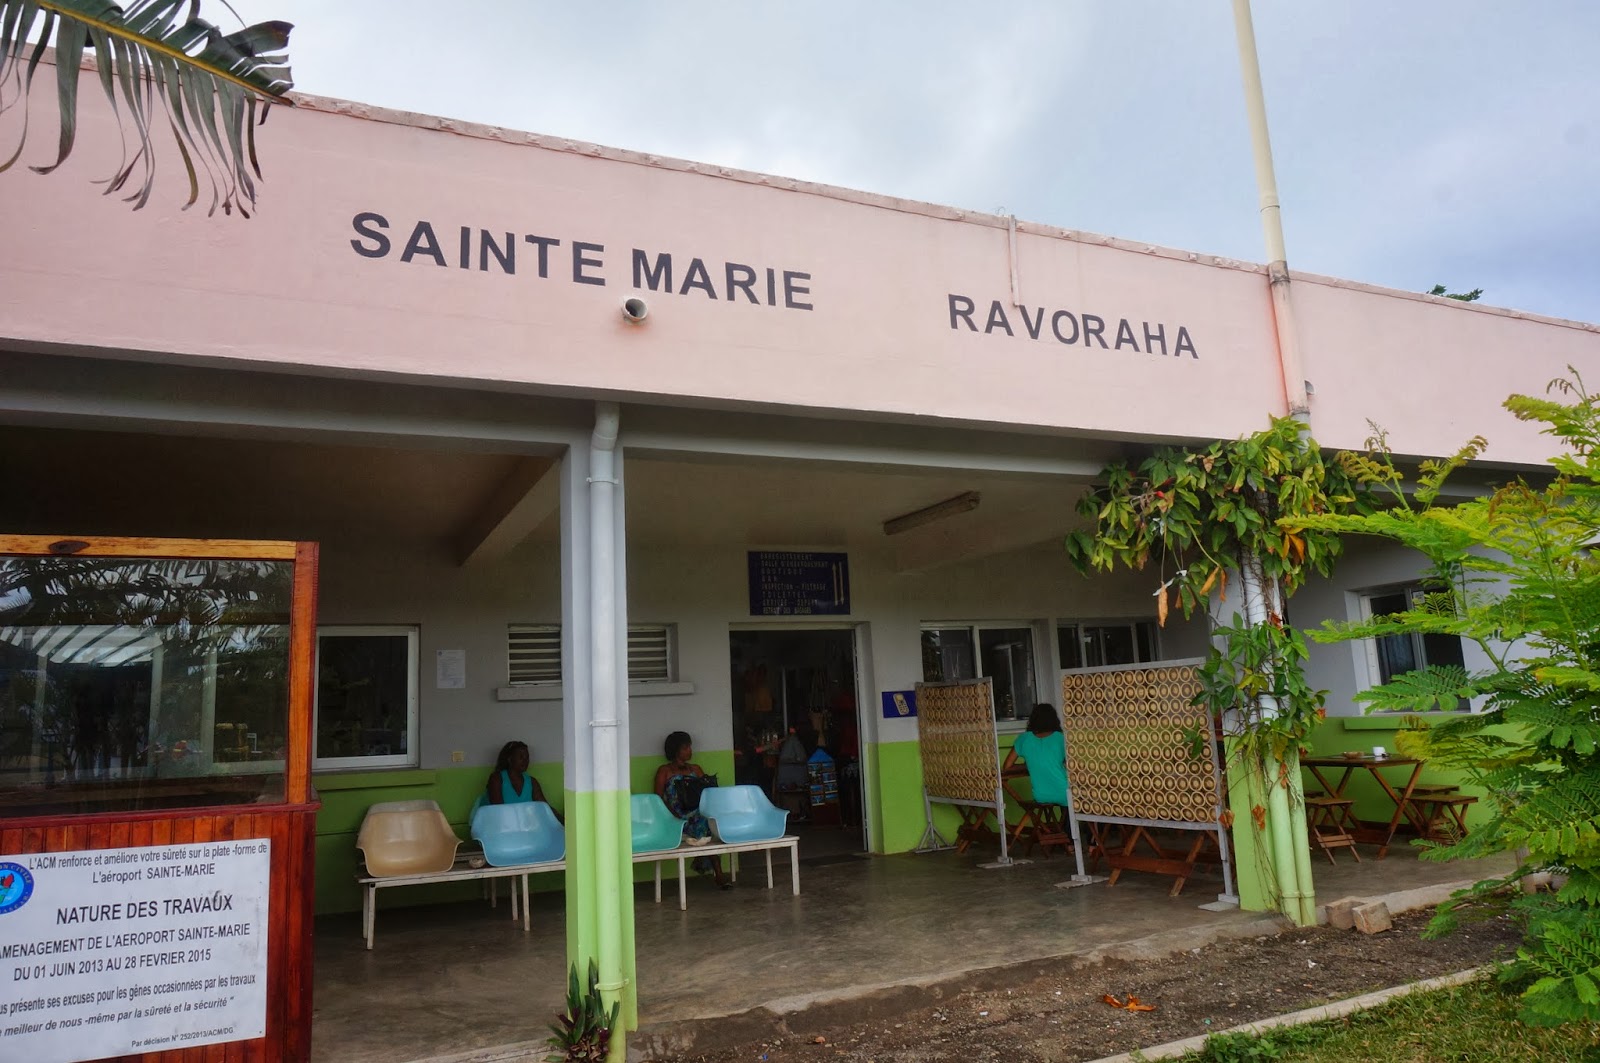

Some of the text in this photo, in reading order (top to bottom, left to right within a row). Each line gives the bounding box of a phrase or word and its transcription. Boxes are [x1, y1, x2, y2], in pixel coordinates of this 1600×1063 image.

[350, 212, 1199, 359] SAINTE MARIE RAVORAHA
[29, 856, 57, 870] L'ACM
[58, 855, 92, 868] renforce
[94, 854, 102, 866] et
[104, 851, 138, 865] améliore
[140, 851, 160, 862] votre
[162, 847, 187, 860] sûreté
[188, 849, 202, 859] sur
[203, 846, 210, 857] la
[211, 845, 230, 859] plate
[258, 842, 267, 853] de
[92, 862, 216, 884] L'aéroport SAINTE-MARIE
[56, 894, 233, 925] NATURE DES TRAVAUX
[0, 923, 251, 959] MENAGEMENT DE L'AEROPORT SAINTE-MARIE
[14, 948, 211, 981] DU 01 JUIN 2013 AU 28 FEVRIER 2015
[10, 998, 45, 1017] présente
[47, 996, 61, 1009] ses
[63, 992, 95, 1006] excuses
[96, 989, 115, 1005] pour
[116, 986, 127, 1000] les
[129, 984, 151, 1001] gênes
[153, 978, 203, 995] occasionnées
[204, 978, 217, 992] par
[218, 975, 228, 988] les
[230, 974, 256, 986] travaux
[4, 1023, 44, 1037] meilleur
[45, 1019, 57, 1031] de
[59, 1017, 82, 1029] nous
[117, 1010, 132, 1024] par
[134, 1008, 142, 1018] la
[144, 1004, 172, 1017] sûreté
[173, 1003, 182, 1013] et
[183, 1001, 191, 1011] la
[194, 997, 227, 1011] sécurité
[131, 1040, 142, 1048] Par
[143, 1036, 170, 1046] décision
[180, 1027, 233, 1041] 252/2013/ACM/DG
